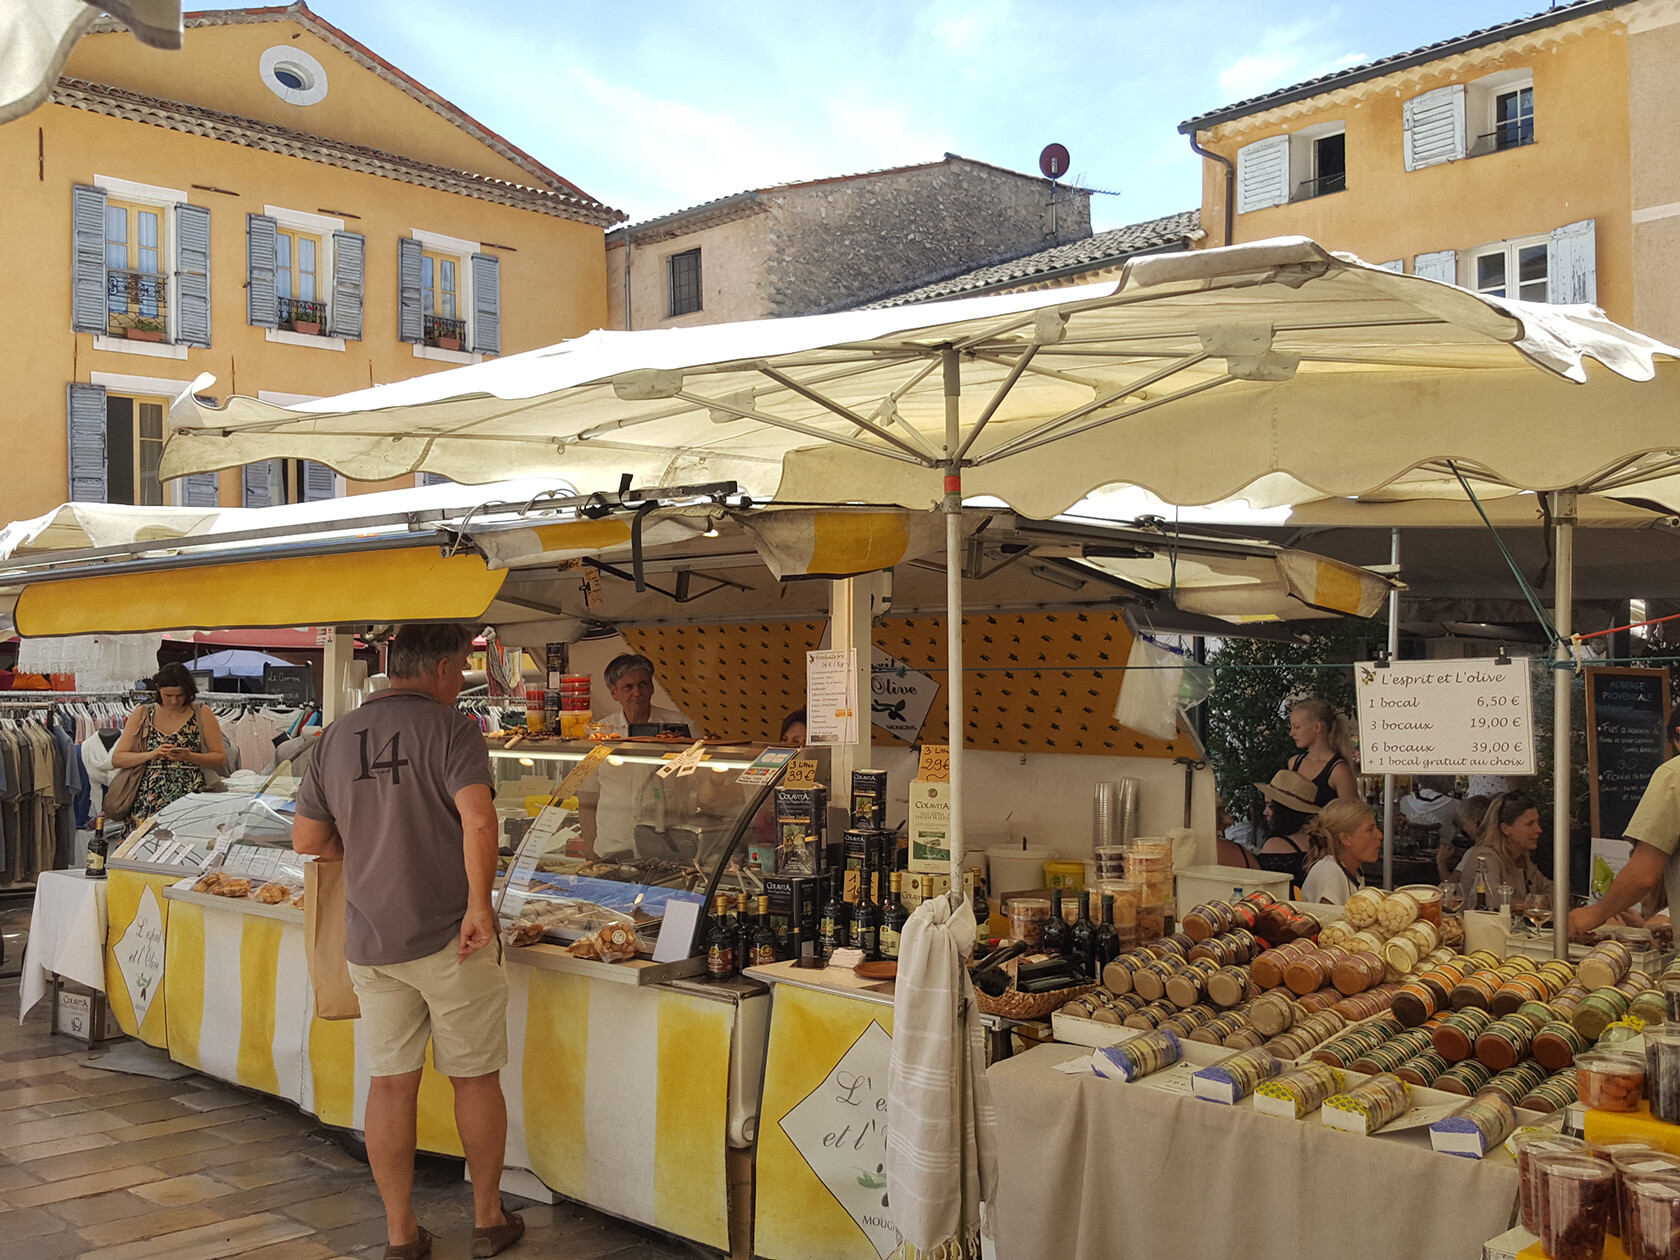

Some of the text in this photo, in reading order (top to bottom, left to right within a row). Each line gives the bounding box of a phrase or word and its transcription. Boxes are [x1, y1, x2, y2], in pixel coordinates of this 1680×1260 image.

[1381, 671, 1506, 688] L'esprit et L'olive
[1369, 696, 1520, 708] 1 bocal 6,50 €
[1370, 716, 1522, 730] 3 bocaux 19,00 €
[924, 746, 932, 756] 3
[1371, 742, 1523, 754] 6 bocaux 39,00 €
[352, 728, 408, 784] 14
[1379, 758, 1384, 766] 1
[1388, 757, 1422, 766] bocal
[1422, 756, 1468, 769] gratuit
[1489, 756, 1526, 766] choix
[790, 760, 796, 770] 3
[822, 1124, 852, 1148] et
[862, 1214, 896, 1232] MOUG
